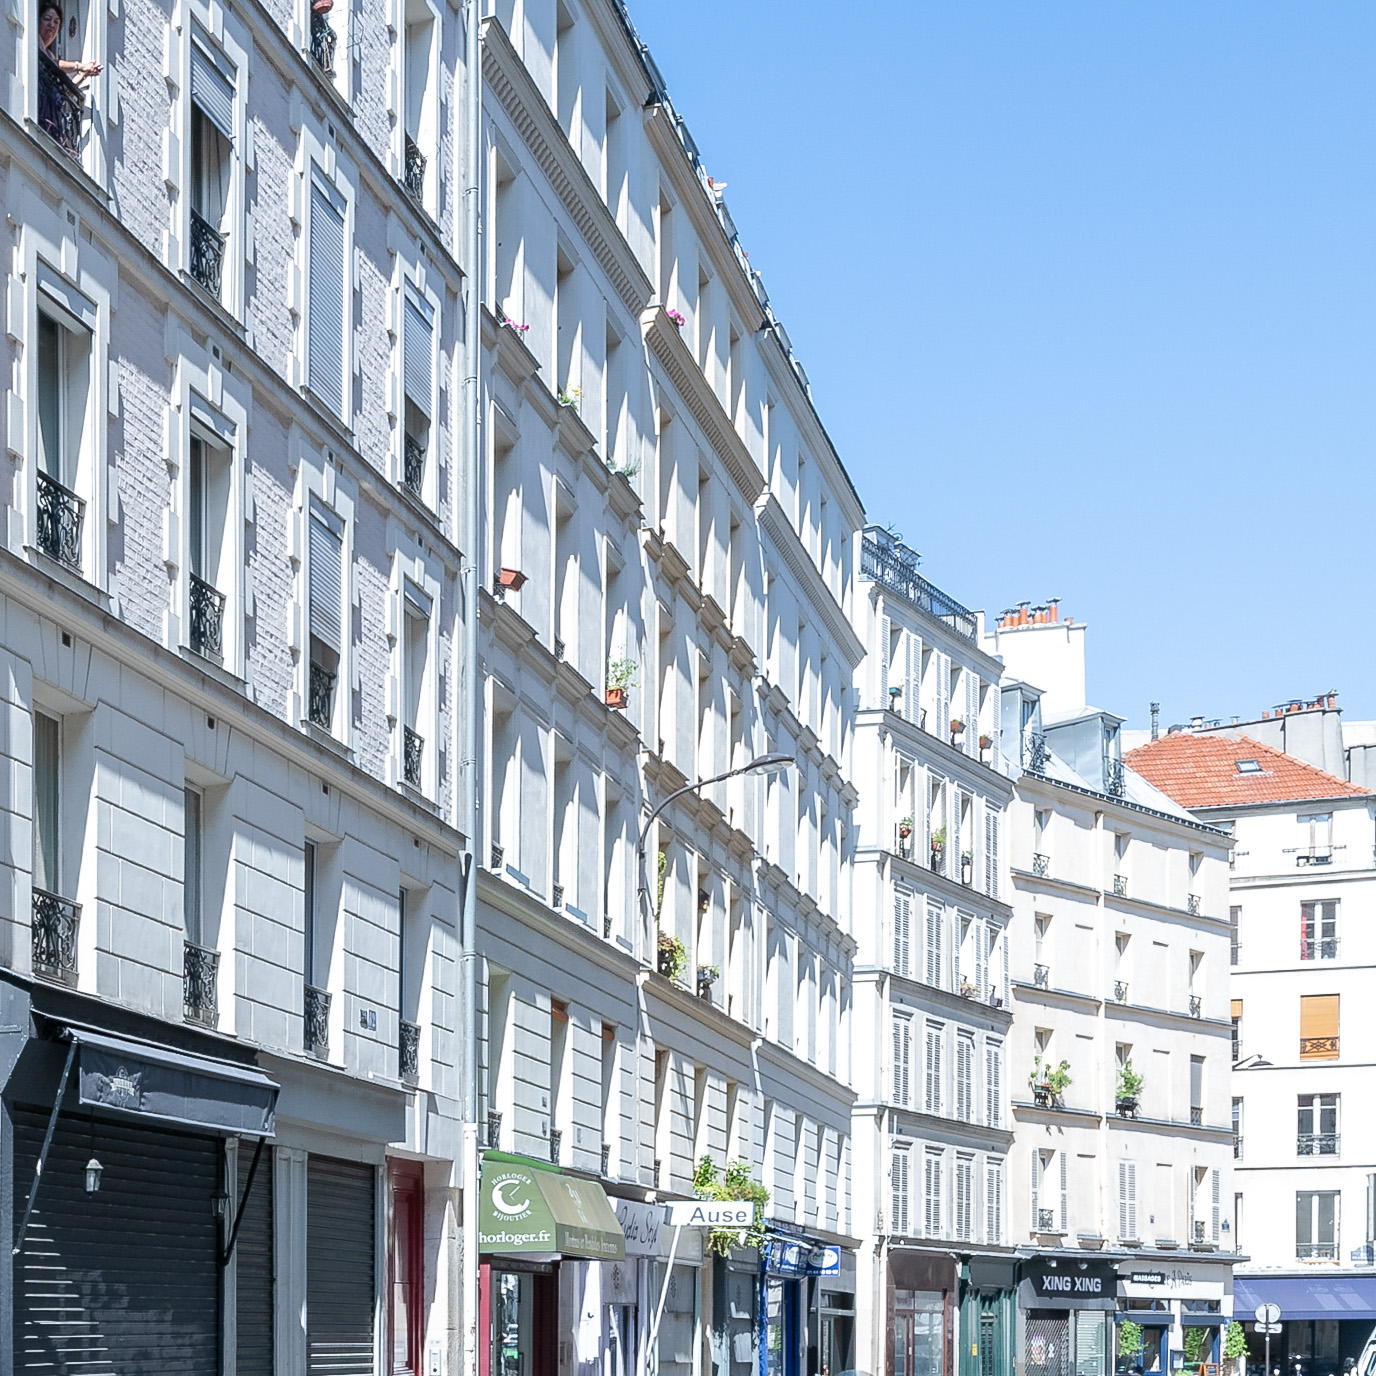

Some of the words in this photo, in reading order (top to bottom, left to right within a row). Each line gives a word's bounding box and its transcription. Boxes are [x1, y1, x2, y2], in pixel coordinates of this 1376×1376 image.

[491, 1173, 532, 1186] HORLOGER
[492, 1209, 533, 1222] BIJOUTIER
[690, 1206, 747, 1223] Ause
[479, 1229, 551, 1246] horloger.fr
[1042, 1275, 1072, 1292] XING
[1074, 1276, 1102, 1293] XING
